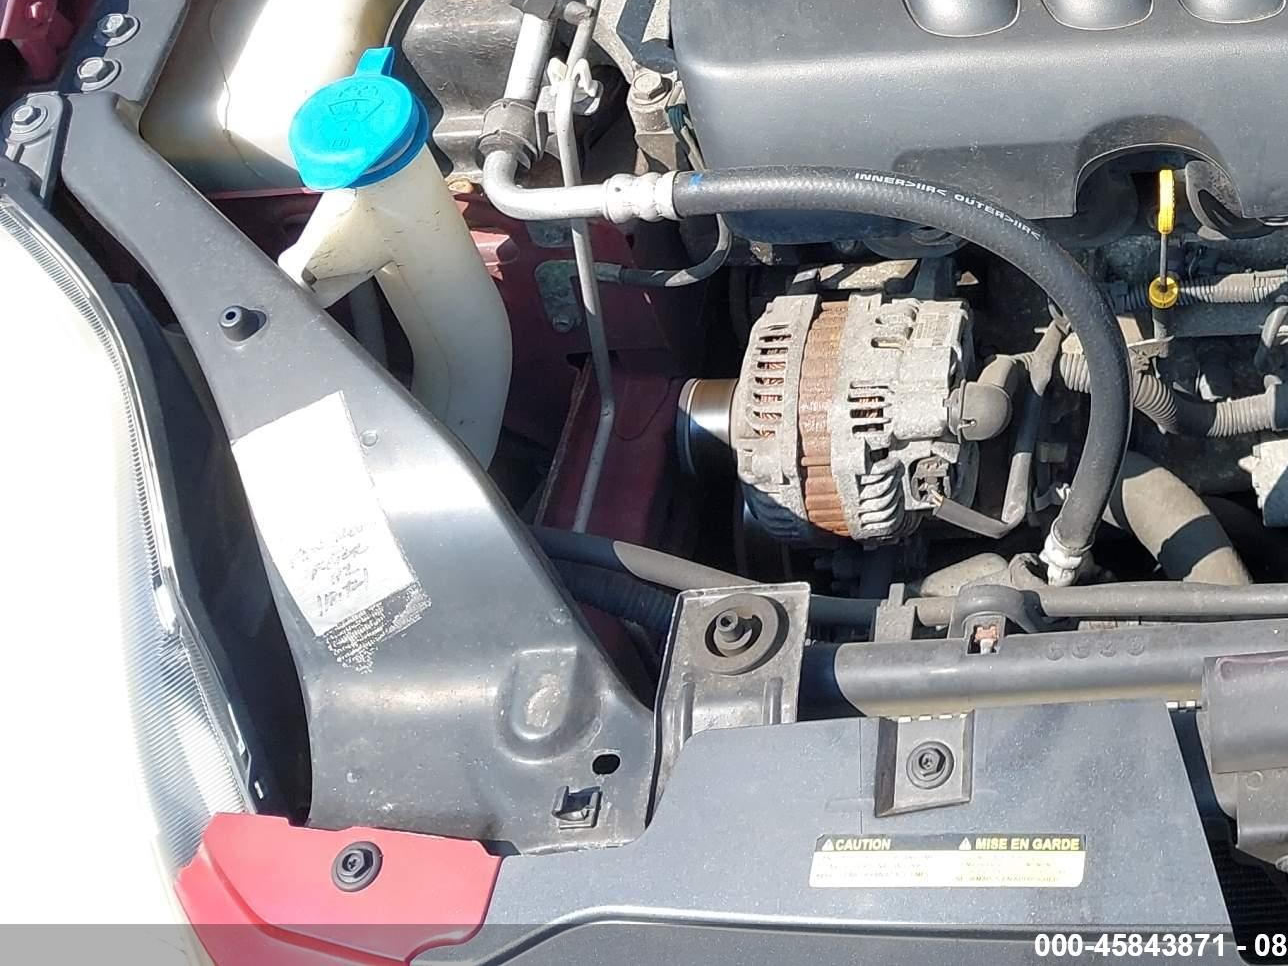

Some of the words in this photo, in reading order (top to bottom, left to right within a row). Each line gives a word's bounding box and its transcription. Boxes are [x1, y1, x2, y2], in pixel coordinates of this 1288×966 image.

[835, 838, 892, 851] CAUTION
[975, 837, 1008, 851] MISE
[1010, 837, 1030, 850] EN
[1032, 837, 1080, 851] GARDE
